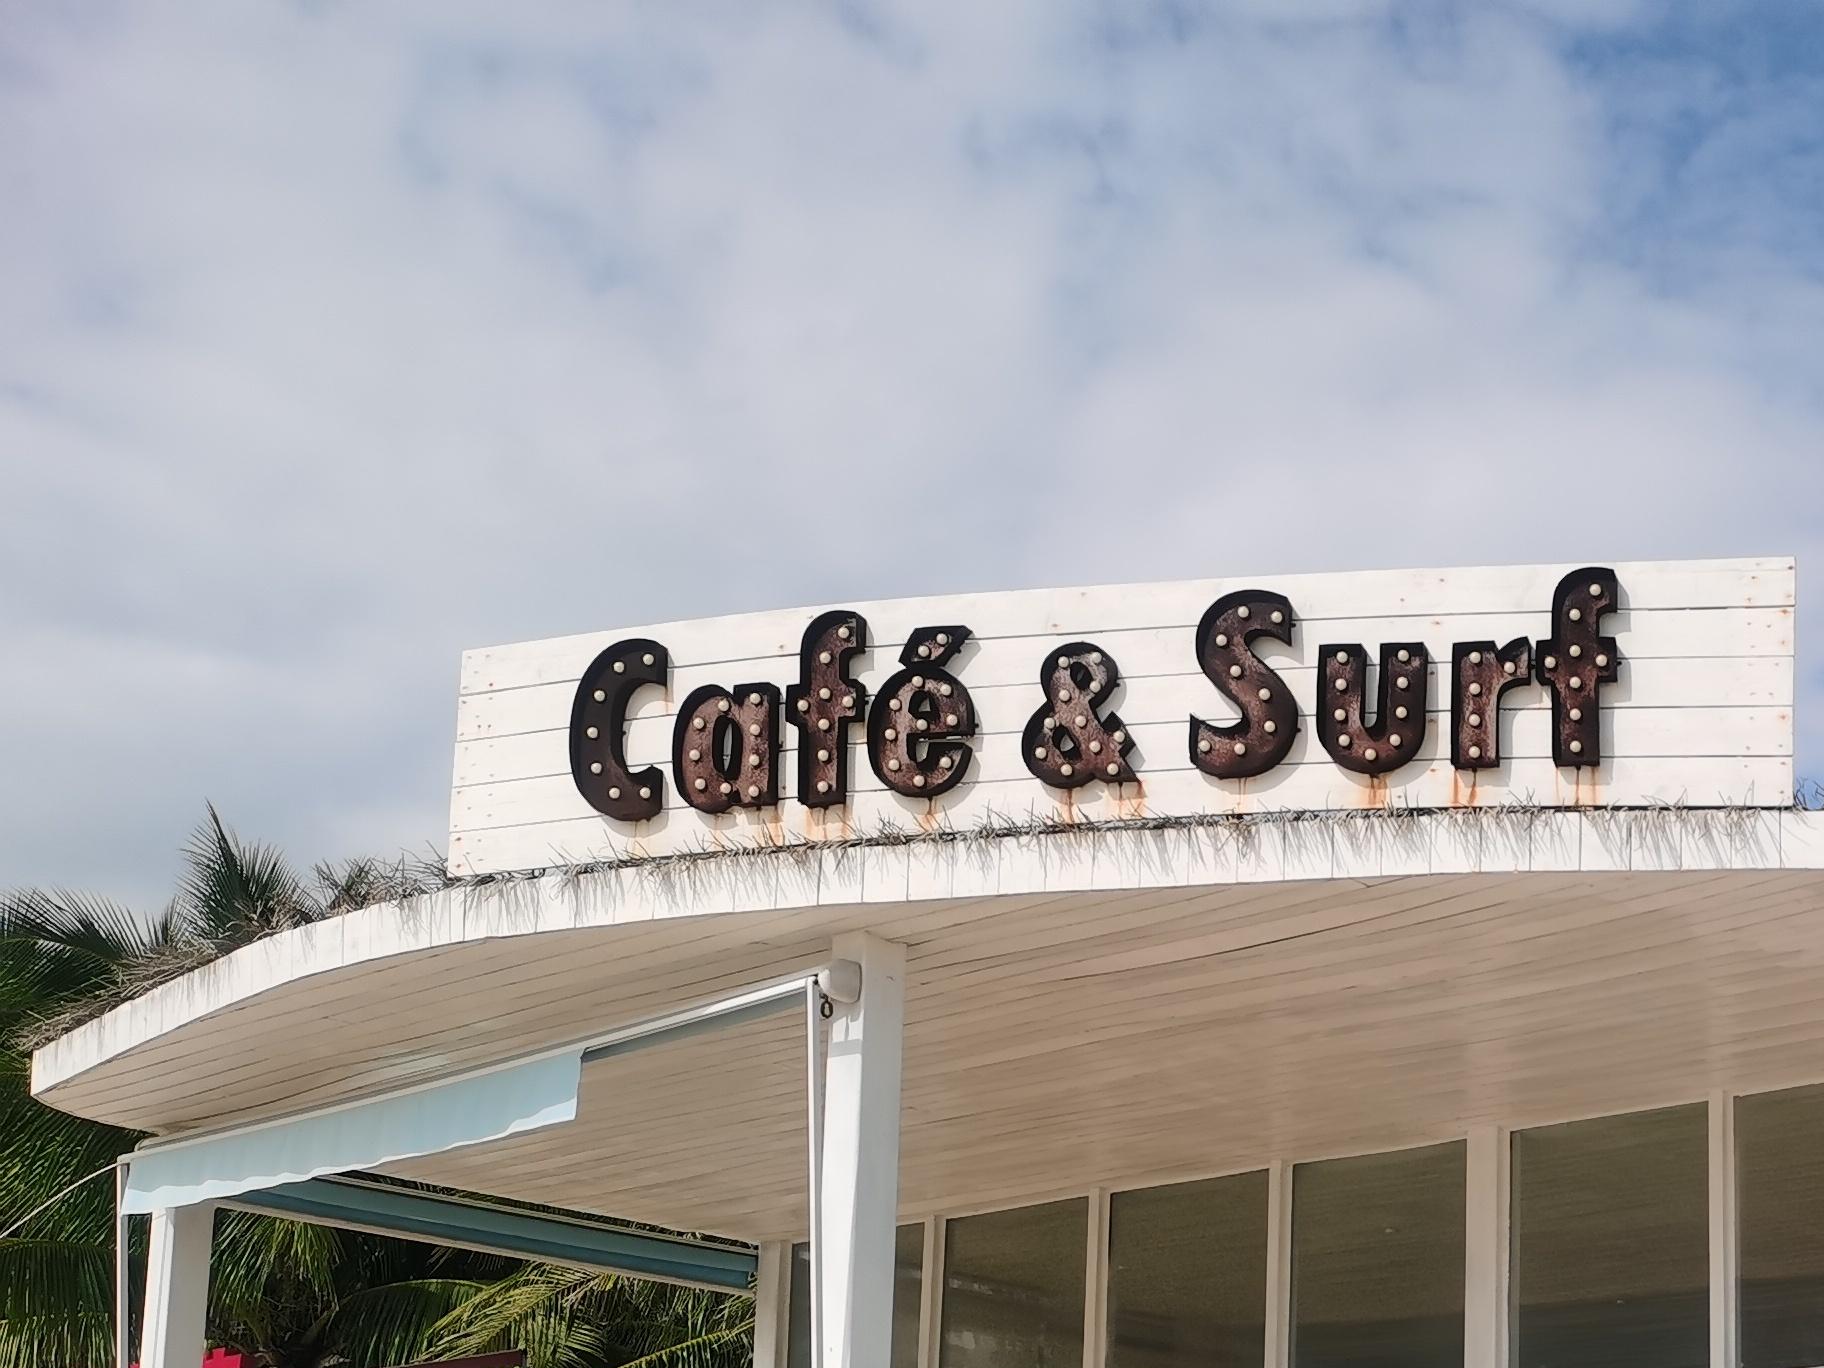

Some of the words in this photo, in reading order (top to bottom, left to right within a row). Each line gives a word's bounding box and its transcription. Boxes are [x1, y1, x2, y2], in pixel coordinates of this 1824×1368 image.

[570, 610, 977, 822] Café
[1023, 642, 1136, 789] &
[1190, 567, 1620, 777] Surf
